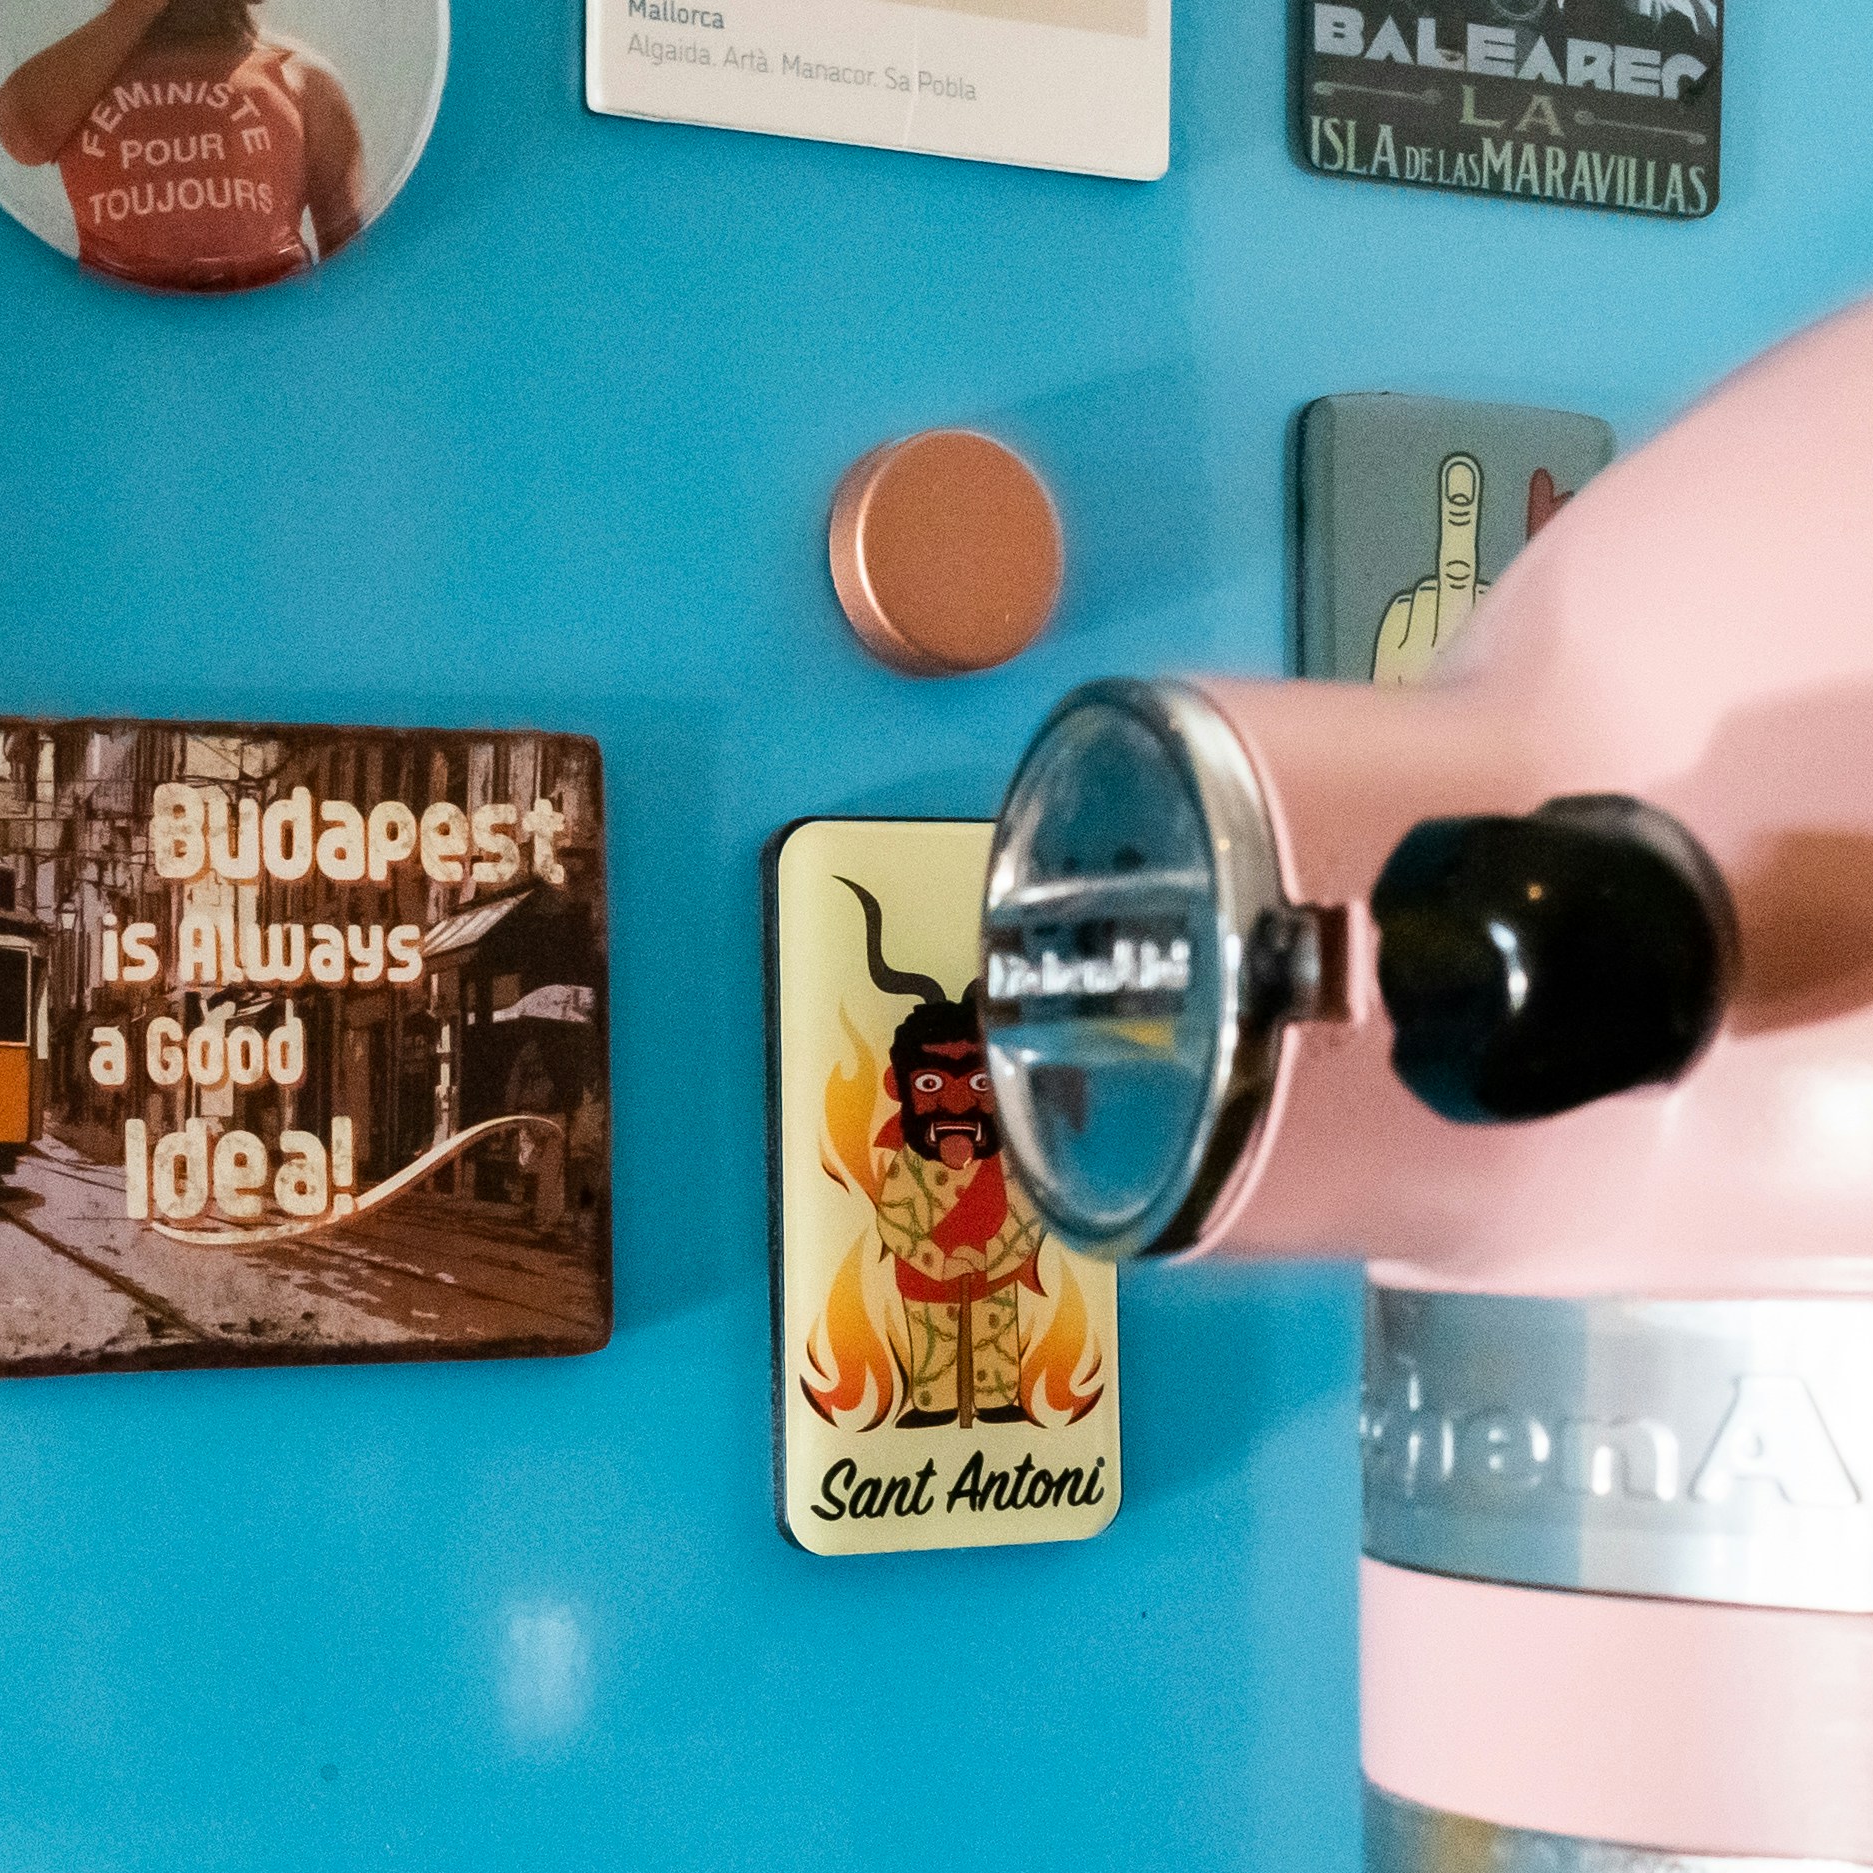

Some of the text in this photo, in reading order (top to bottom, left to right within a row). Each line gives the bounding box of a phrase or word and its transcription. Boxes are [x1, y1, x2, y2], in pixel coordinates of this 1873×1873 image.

[628, 0, 725, 29] Mallorca
[81, 77, 271, 158] FEMINISTE
[884, 66, 911, 93] Sa
[917, 71, 978, 101] Pobla
[1460, 84, 1565, 137] LA
[119, 132, 225, 170] POUR
[1310, 115, 1709, 215] ISLA DE LAS MARAVILLAS
[89, 177, 274, 224] TOUJOURS
[152, 783, 566, 885] Budapest
[101, 908, 424, 983] is Always
[89, 1002, 305, 1087] a Good
[125, 1115, 354, 1220] Idea!
[810, 1450, 1106, 1522] Sant Antoni
